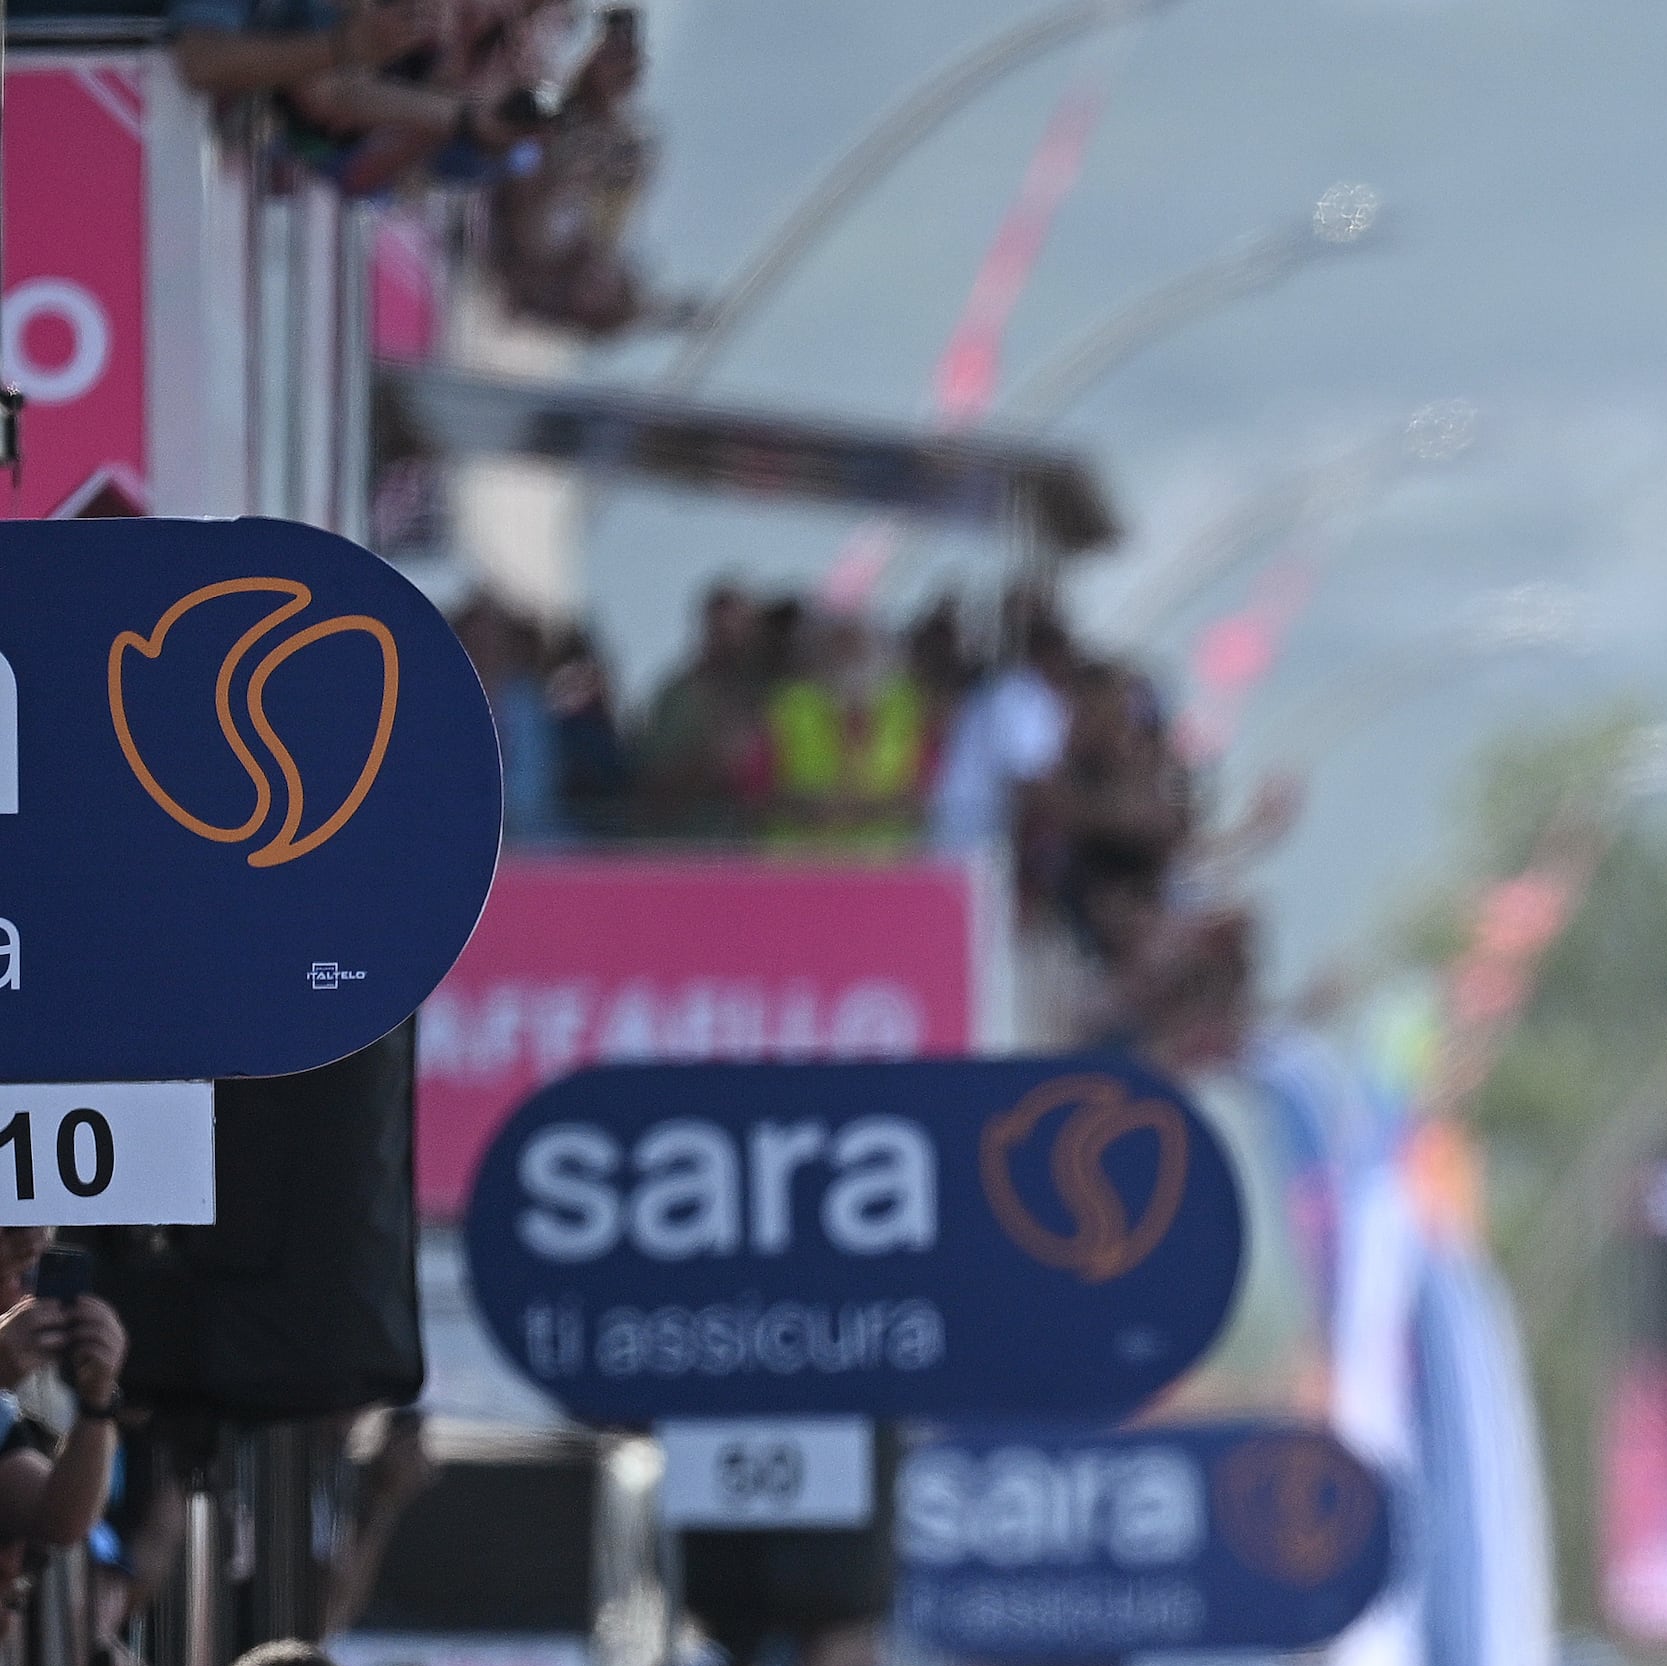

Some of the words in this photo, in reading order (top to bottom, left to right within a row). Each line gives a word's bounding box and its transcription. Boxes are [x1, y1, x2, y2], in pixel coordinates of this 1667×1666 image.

[514, 1110, 940, 1264] sara
[523, 1293, 580, 1385] ti
[594, 1293, 946, 1380] assicura
